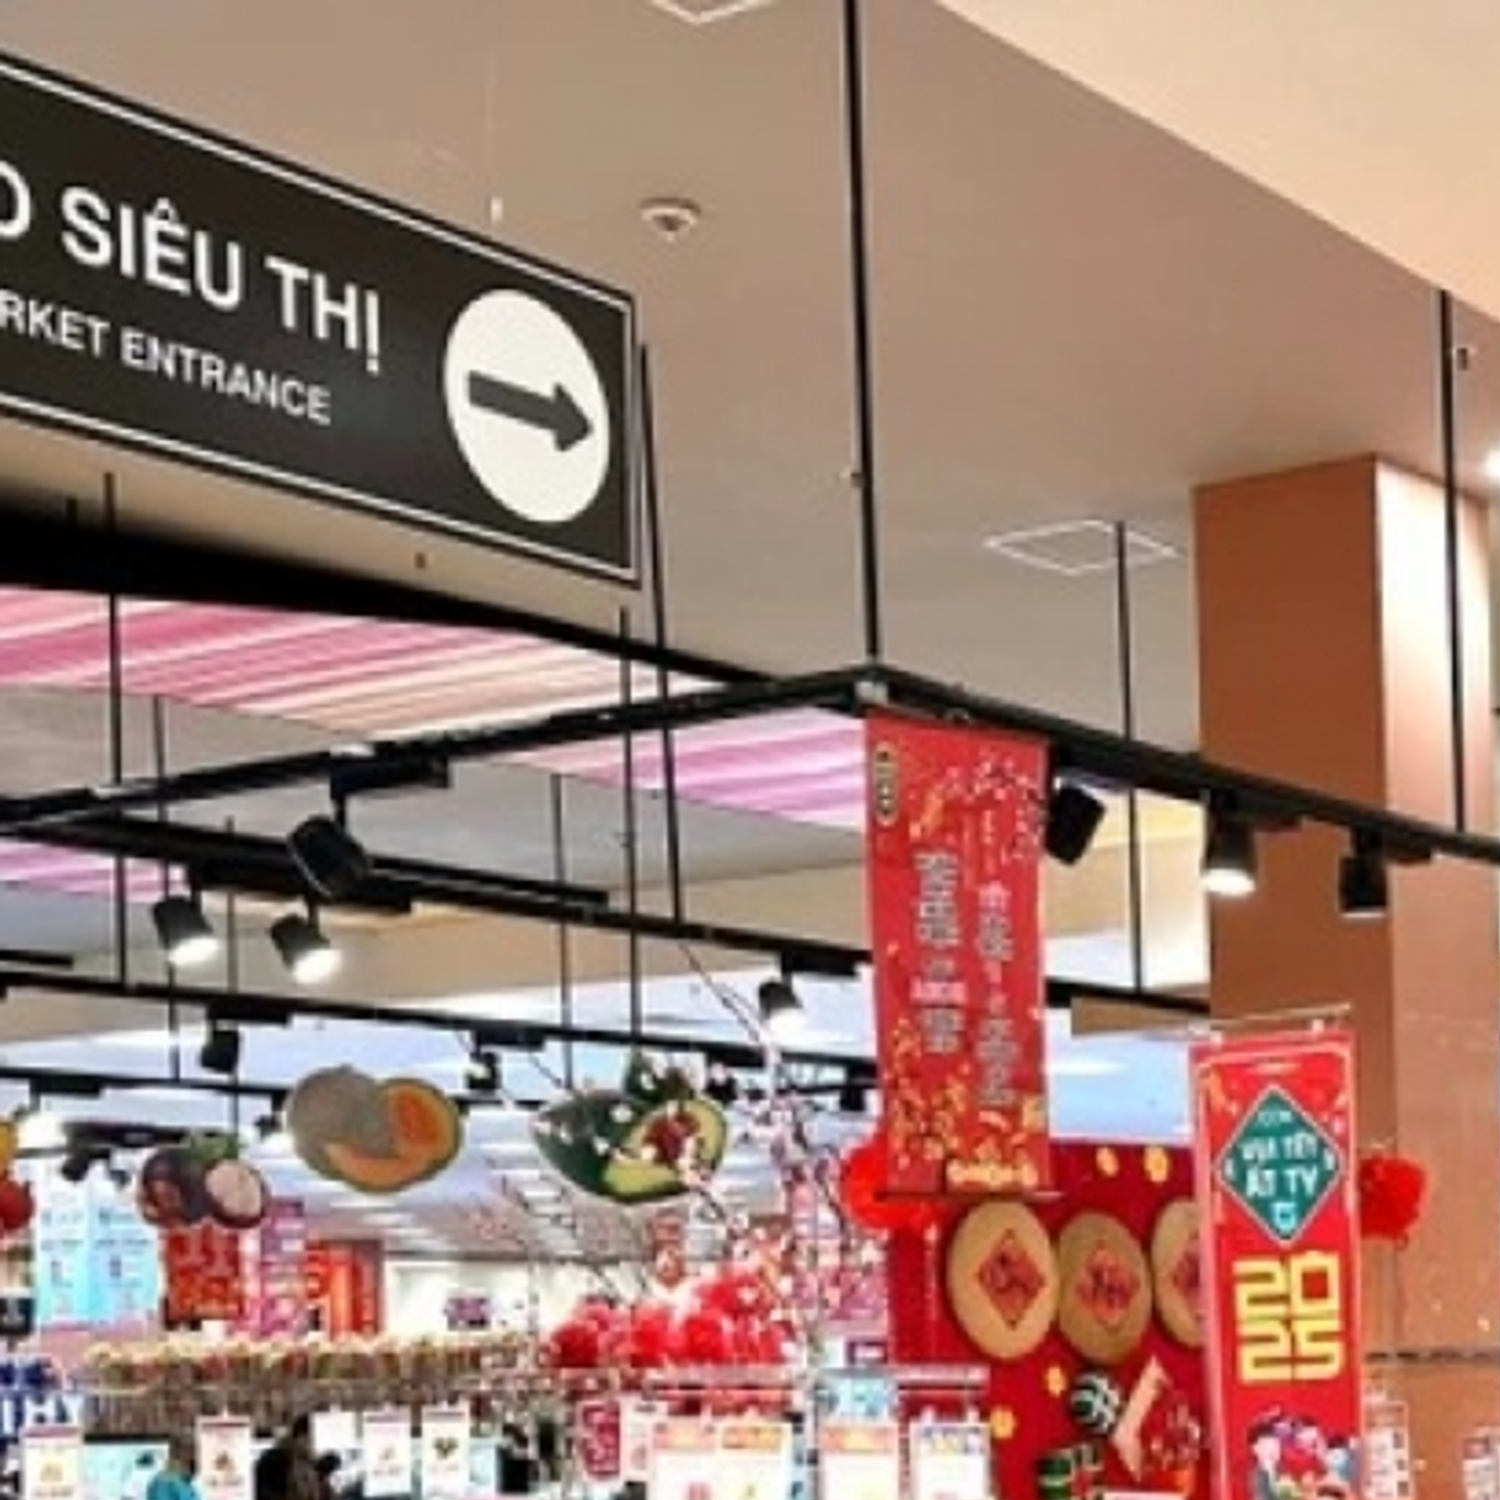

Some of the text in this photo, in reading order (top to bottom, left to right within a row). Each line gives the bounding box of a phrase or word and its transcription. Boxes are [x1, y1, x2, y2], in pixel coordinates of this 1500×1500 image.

[61, 187, 242, 311] SIÊU
[264, 254, 380, 376] THỊ
[120, 325, 331, 427] ENTRANCE
